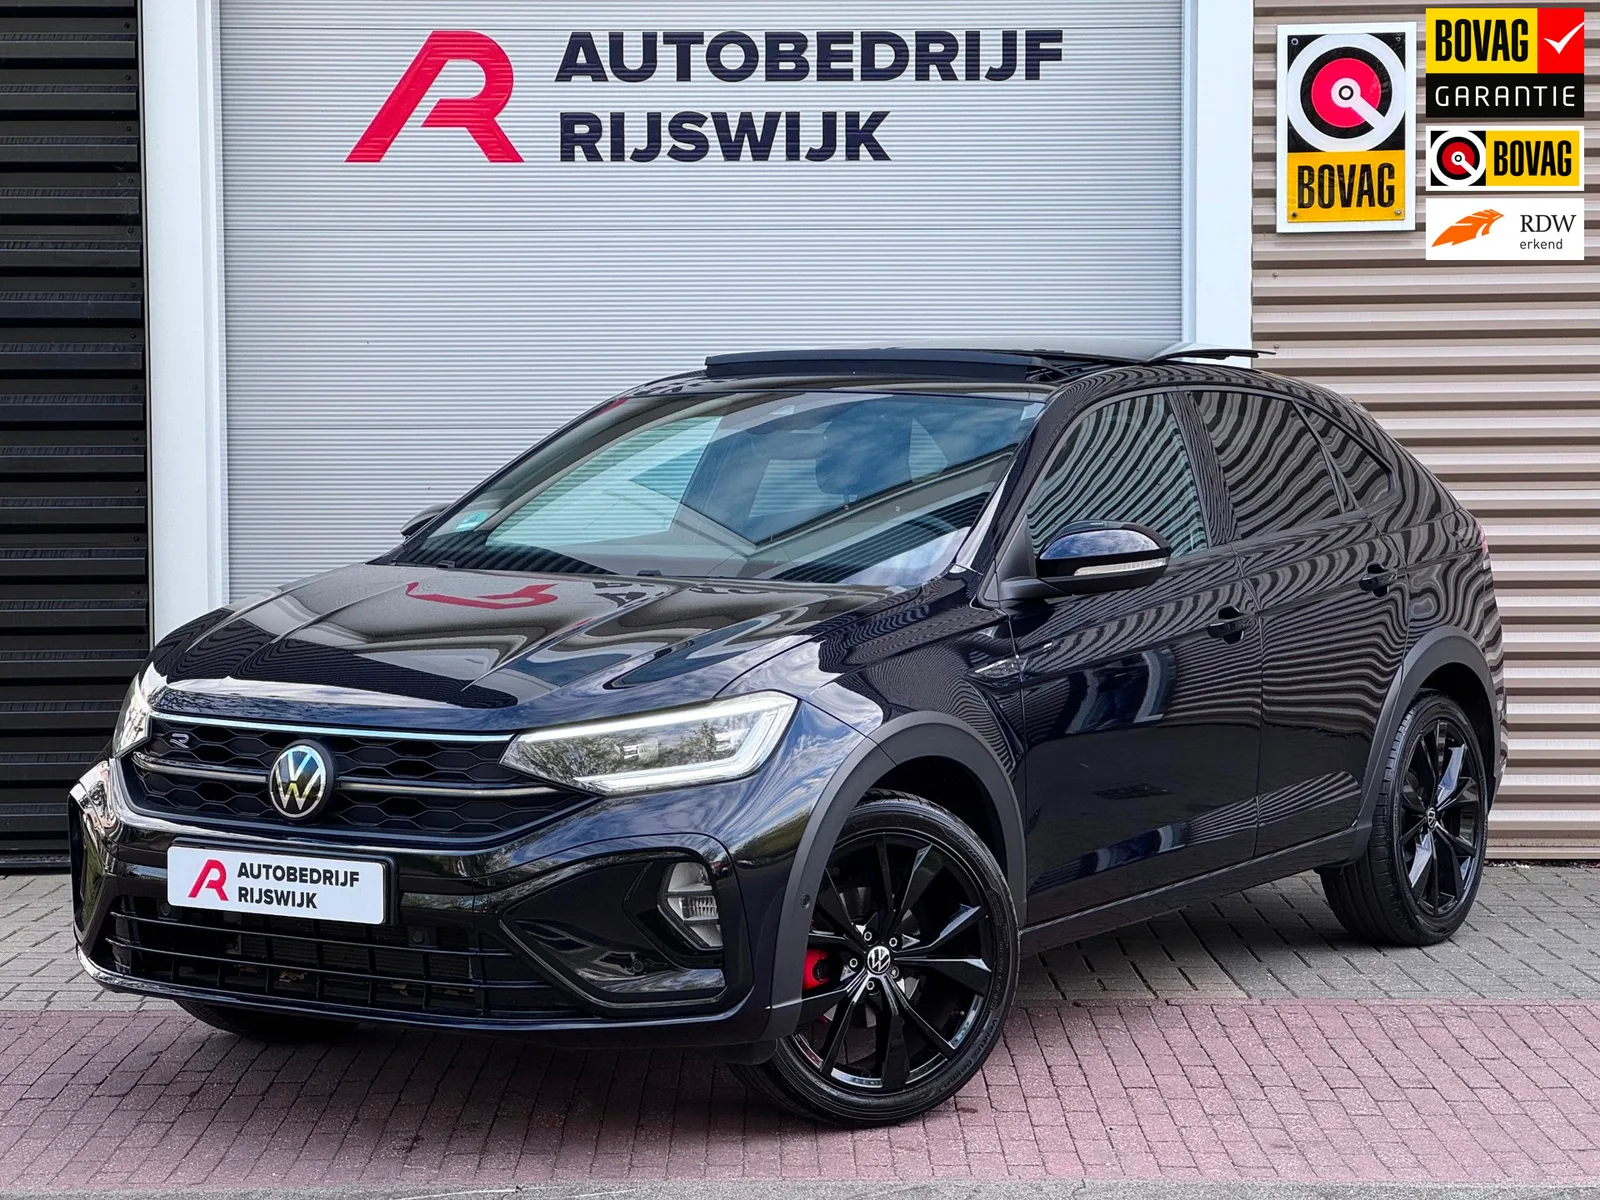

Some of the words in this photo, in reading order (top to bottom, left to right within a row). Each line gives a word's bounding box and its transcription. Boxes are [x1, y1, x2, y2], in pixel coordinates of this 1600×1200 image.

[554, 30, 1063, 82] AUTOBEDRIJF
[559, 111, 892, 162] RIJSWIJK
[1297, 162, 1395, 210] BOVAG
[237, 862, 360, 888] AUTOBEDRIJF
[237, 886, 318, 909] RIJSWIJK
